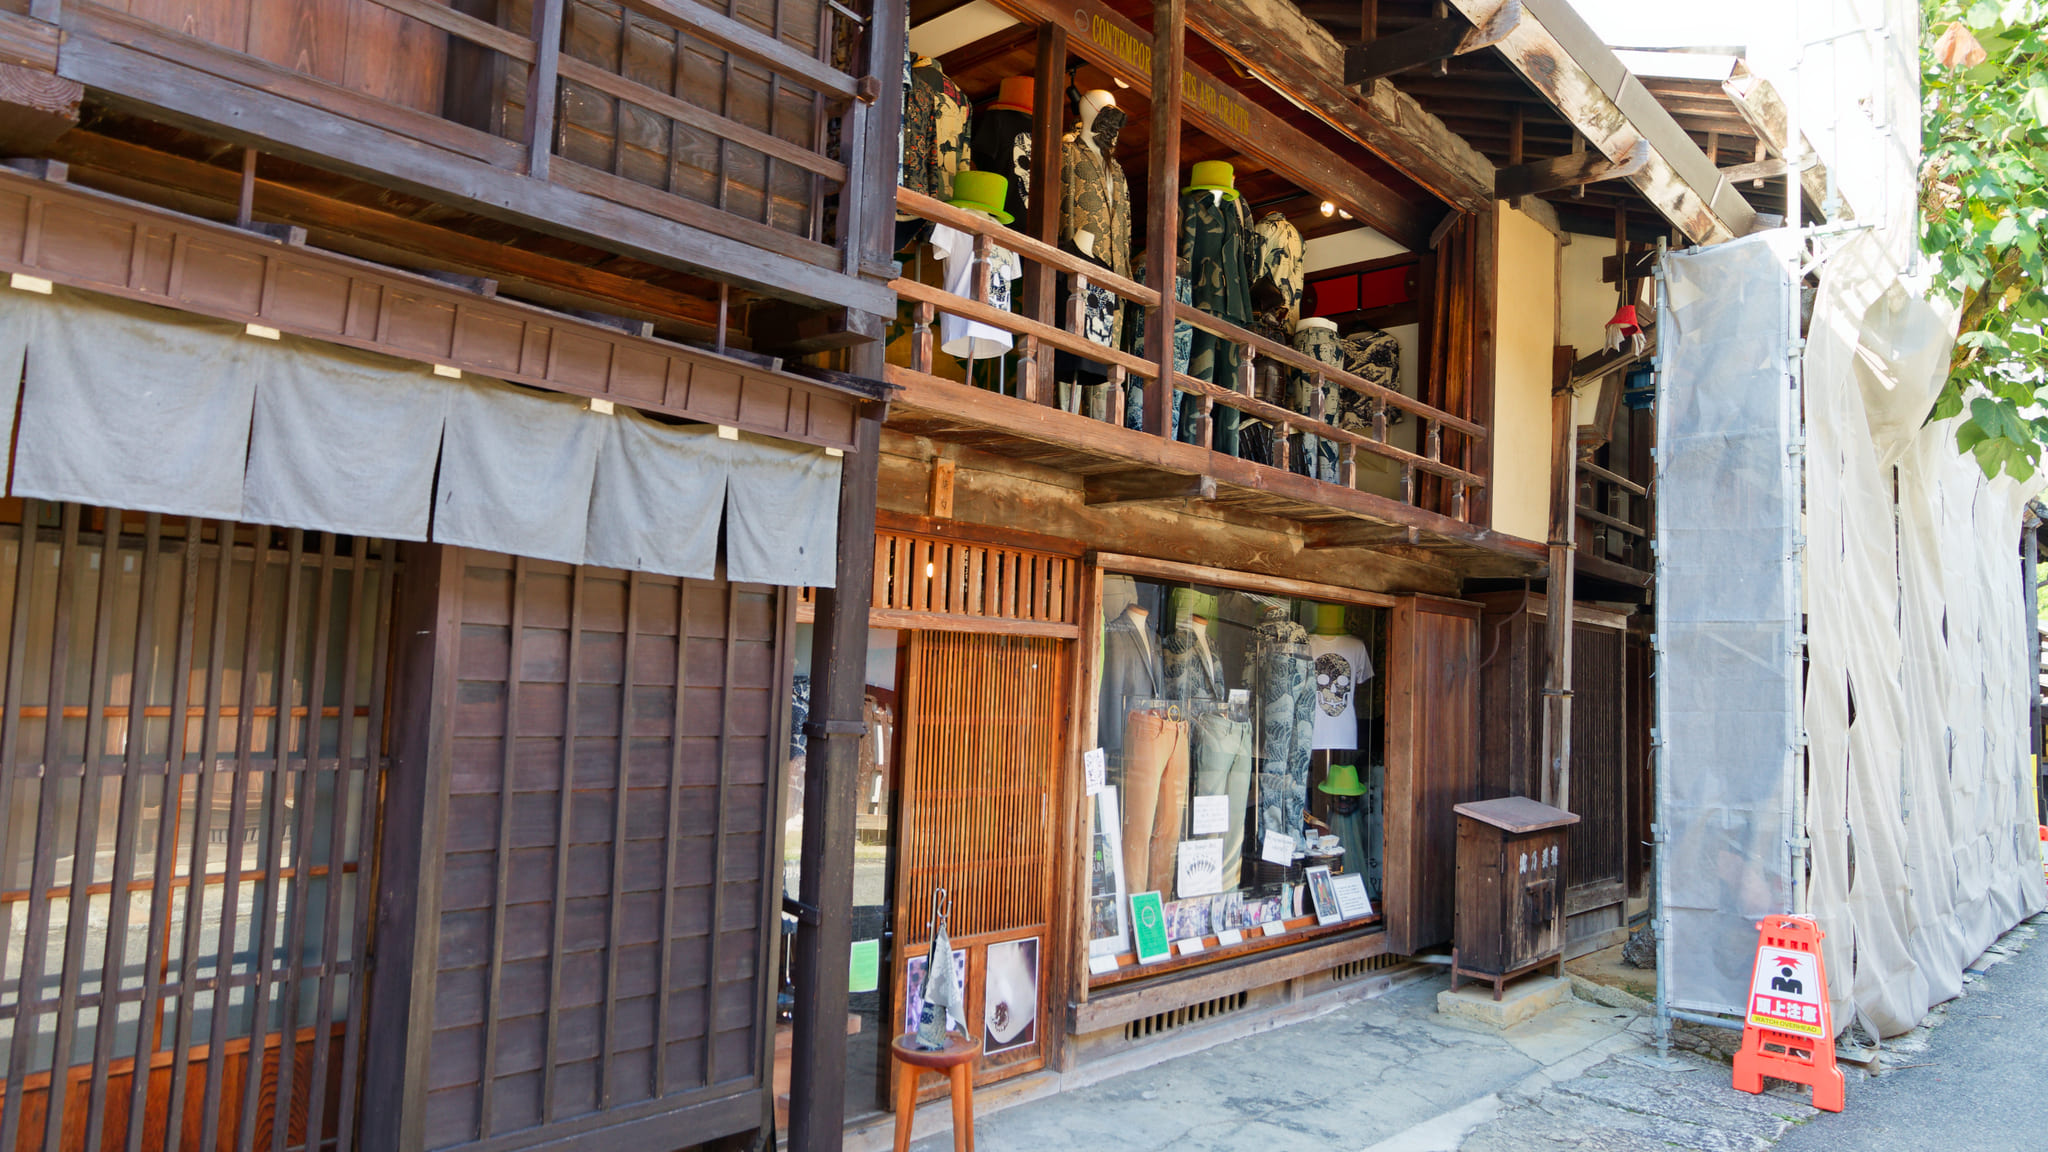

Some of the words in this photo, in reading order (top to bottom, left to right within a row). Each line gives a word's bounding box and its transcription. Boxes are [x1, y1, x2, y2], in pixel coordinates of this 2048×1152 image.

[1092, 14, 1151, 76] CONTEMPOR
[1199, 81, 1217, 115] AND
[1218, 94, 1249, 136] CRAFTS
[1756, 996, 1818, 1023] 頭上注意
[1754, 1016, 1778, 1025] WATCH
[1779, 1020, 1817, 1033] OVERHEAD
